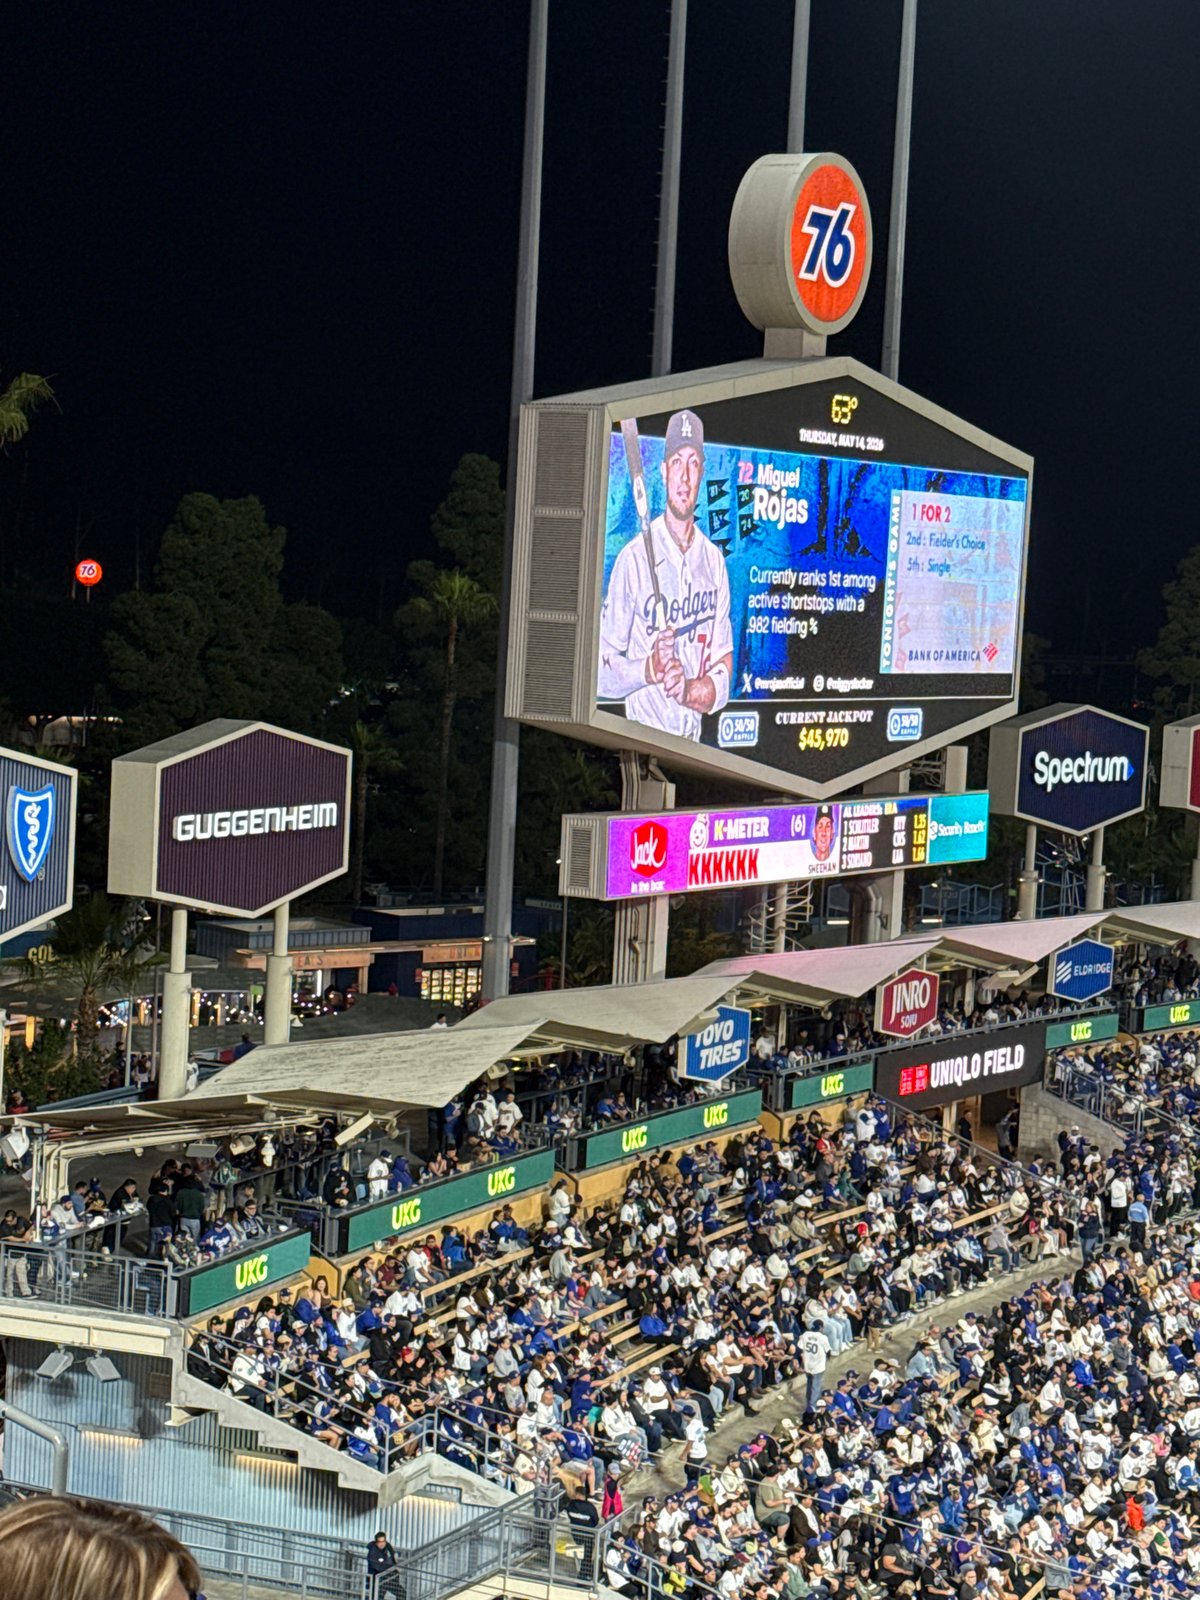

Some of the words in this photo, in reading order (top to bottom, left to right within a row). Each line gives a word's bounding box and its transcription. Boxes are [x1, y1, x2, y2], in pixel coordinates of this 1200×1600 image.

[799, 202, 856, 288] 76
[799, 428, 838, 447] THURSDAY,
[839, 434, 855, 448] MAY
[866, 436, 884, 451] 2026
[738, 462, 753, 483] 72
[757, 464, 799, 492] Miguel
[753, 488, 809, 530] Rojas
[912, 503, 917, 522] 1
[920, 504, 941, 523] FOR
[944, 506, 951, 523] 2
[929, 534, 960, 549] Fielder's
[961, 536, 985, 550] Choice
[80, 564, 97, 578] 76
[750, 565, 797, 589] Currently
[798, 571, 826, 586] ranks
[828, 570, 841, 587] 1st
[842, 574, 877, 593] among
[927, 558, 951, 577] Single
[748, 591, 780, 609] active
[781, 593, 834, 614] shortstops
[836, 595, 857, 611] with
[857, 598, 865, 612] a
[882, 560, 897, 668] TONIGHT'S
[746, 616, 769, 633] .982
[771, 616, 808, 639] fielding
[809, 617, 818, 635] %
[908, 650, 931, 662] BANK
[933, 650, 943, 662] OF
[944, 650, 981, 662] AMERICA
[775, 711, 825, 725] CURRENT
[827, 710, 874, 724] JACKPOT
[799, 726, 849, 752] $45,970
[1034, 750, 1129, 793] Spectrum
[173, 802, 338, 841] GUGGENHEIM
[790, 812, 806, 837] (6)
[631, 826, 667, 870] Jack
[689, 848, 759, 886] KKKKKK
[1074, 962, 1111, 977] ELDRIDGE
[889, 977, 930, 1025] JINRO
[1170, 1004, 1190, 1023] UKG
[1071, 1021, 1092, 1042] UKG
[930, 1053, 982, 1089] UNIQLO
[983, 1044, 1025, 1077] FIELD
[821, 1073, 844, 1097] UKG
[703, 1102, 728, 1128] UKG
[622, 1125, 648, 1153] UKG
[487, 1166, 516, 1196] UKG
[392, 1198, 421, 1230] UKG
[235, 1253, 268, 1290] UKG
[806, 1342, 818, 1355] 50
